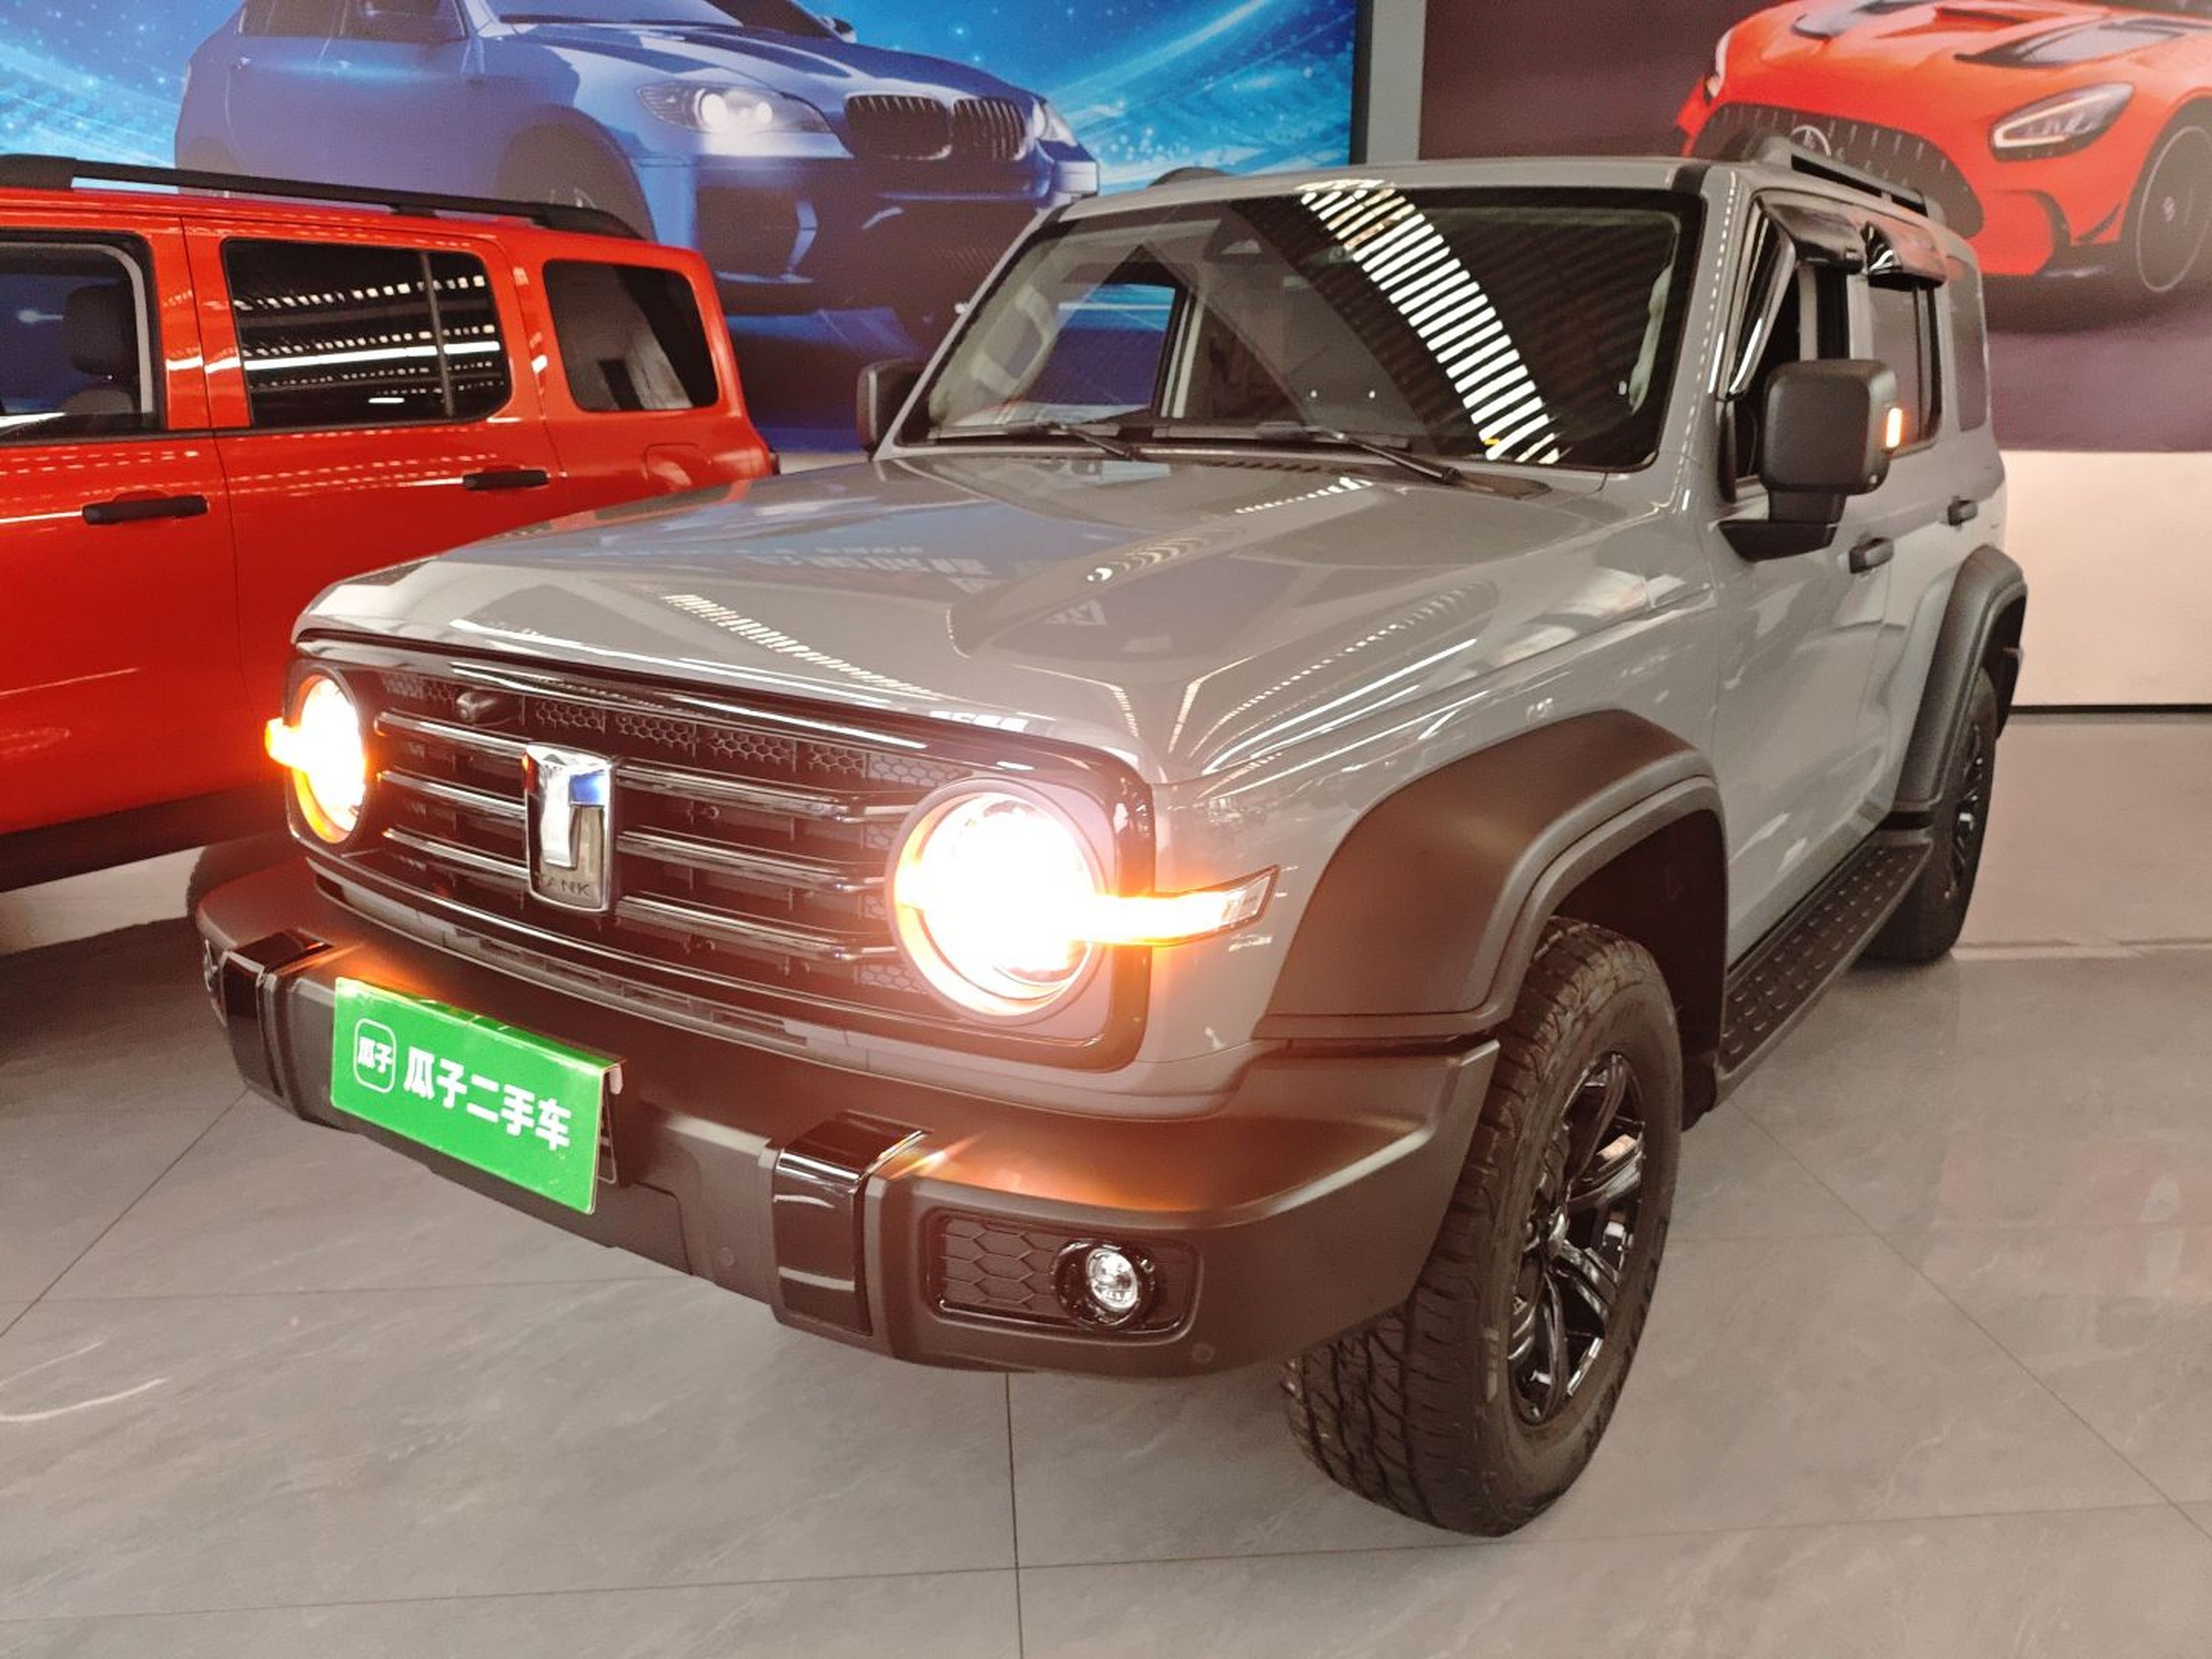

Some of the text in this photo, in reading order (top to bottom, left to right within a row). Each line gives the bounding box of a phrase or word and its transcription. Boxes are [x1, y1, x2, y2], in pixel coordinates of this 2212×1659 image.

[358, 1037, 393, 1074] 瓜子
[404, 1046, 571, 1151] 瓜子二手车
